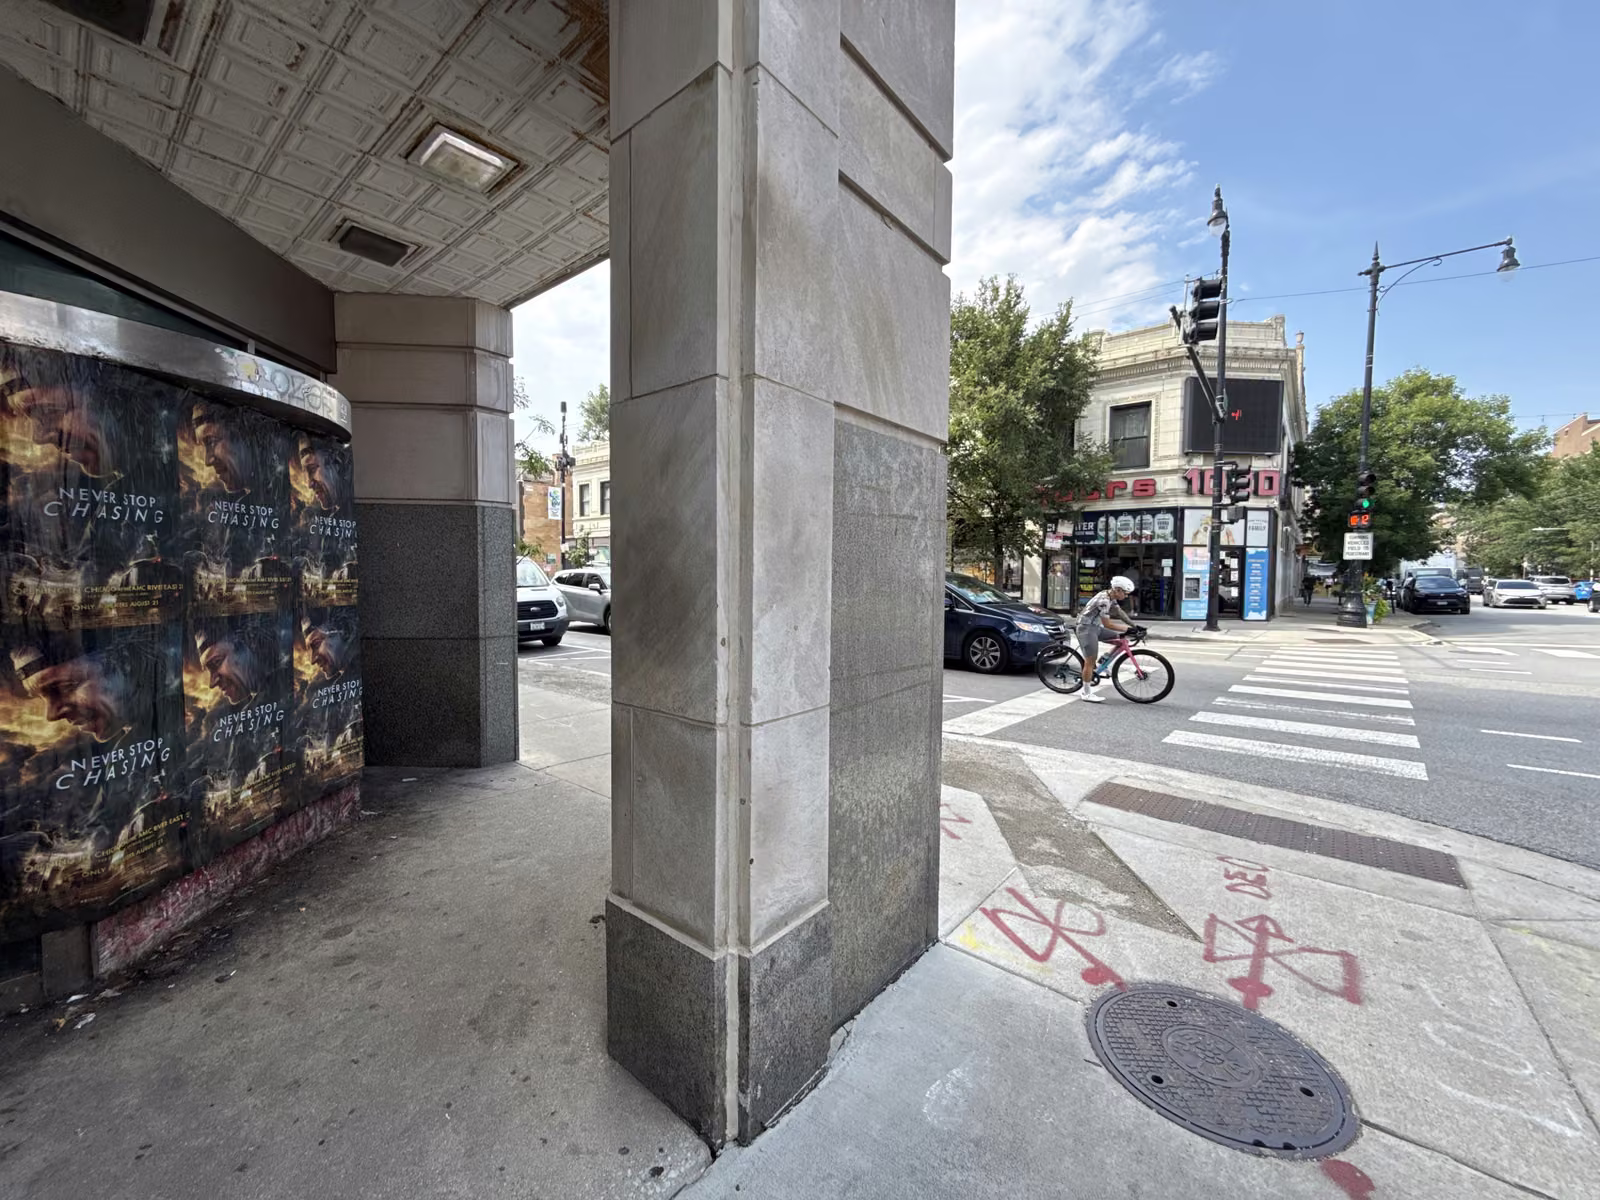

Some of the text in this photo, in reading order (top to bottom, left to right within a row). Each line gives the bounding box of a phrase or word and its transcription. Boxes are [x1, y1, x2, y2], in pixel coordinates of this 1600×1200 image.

[60, 487, 156, 508] NEVER STOP
[43, 501, 163, 523] CHASING
[214, 501, 273, 516] NEVER STOP
[208, 511, 280, 529] CHASING
[315, 516, 357, 529] NEVER STOP
[309, 524, 358, 539] CHASIN
[318, 683, 340, 698] NEVER
[219, 701, 277, 728] NEVER STOP
[213, 710, 284, 742] CHASING
[71, 737, 163, 772] NEVER STOP
[56, 747, 171, 790] CHASING
[82, 866, 106, 878] ONLY
